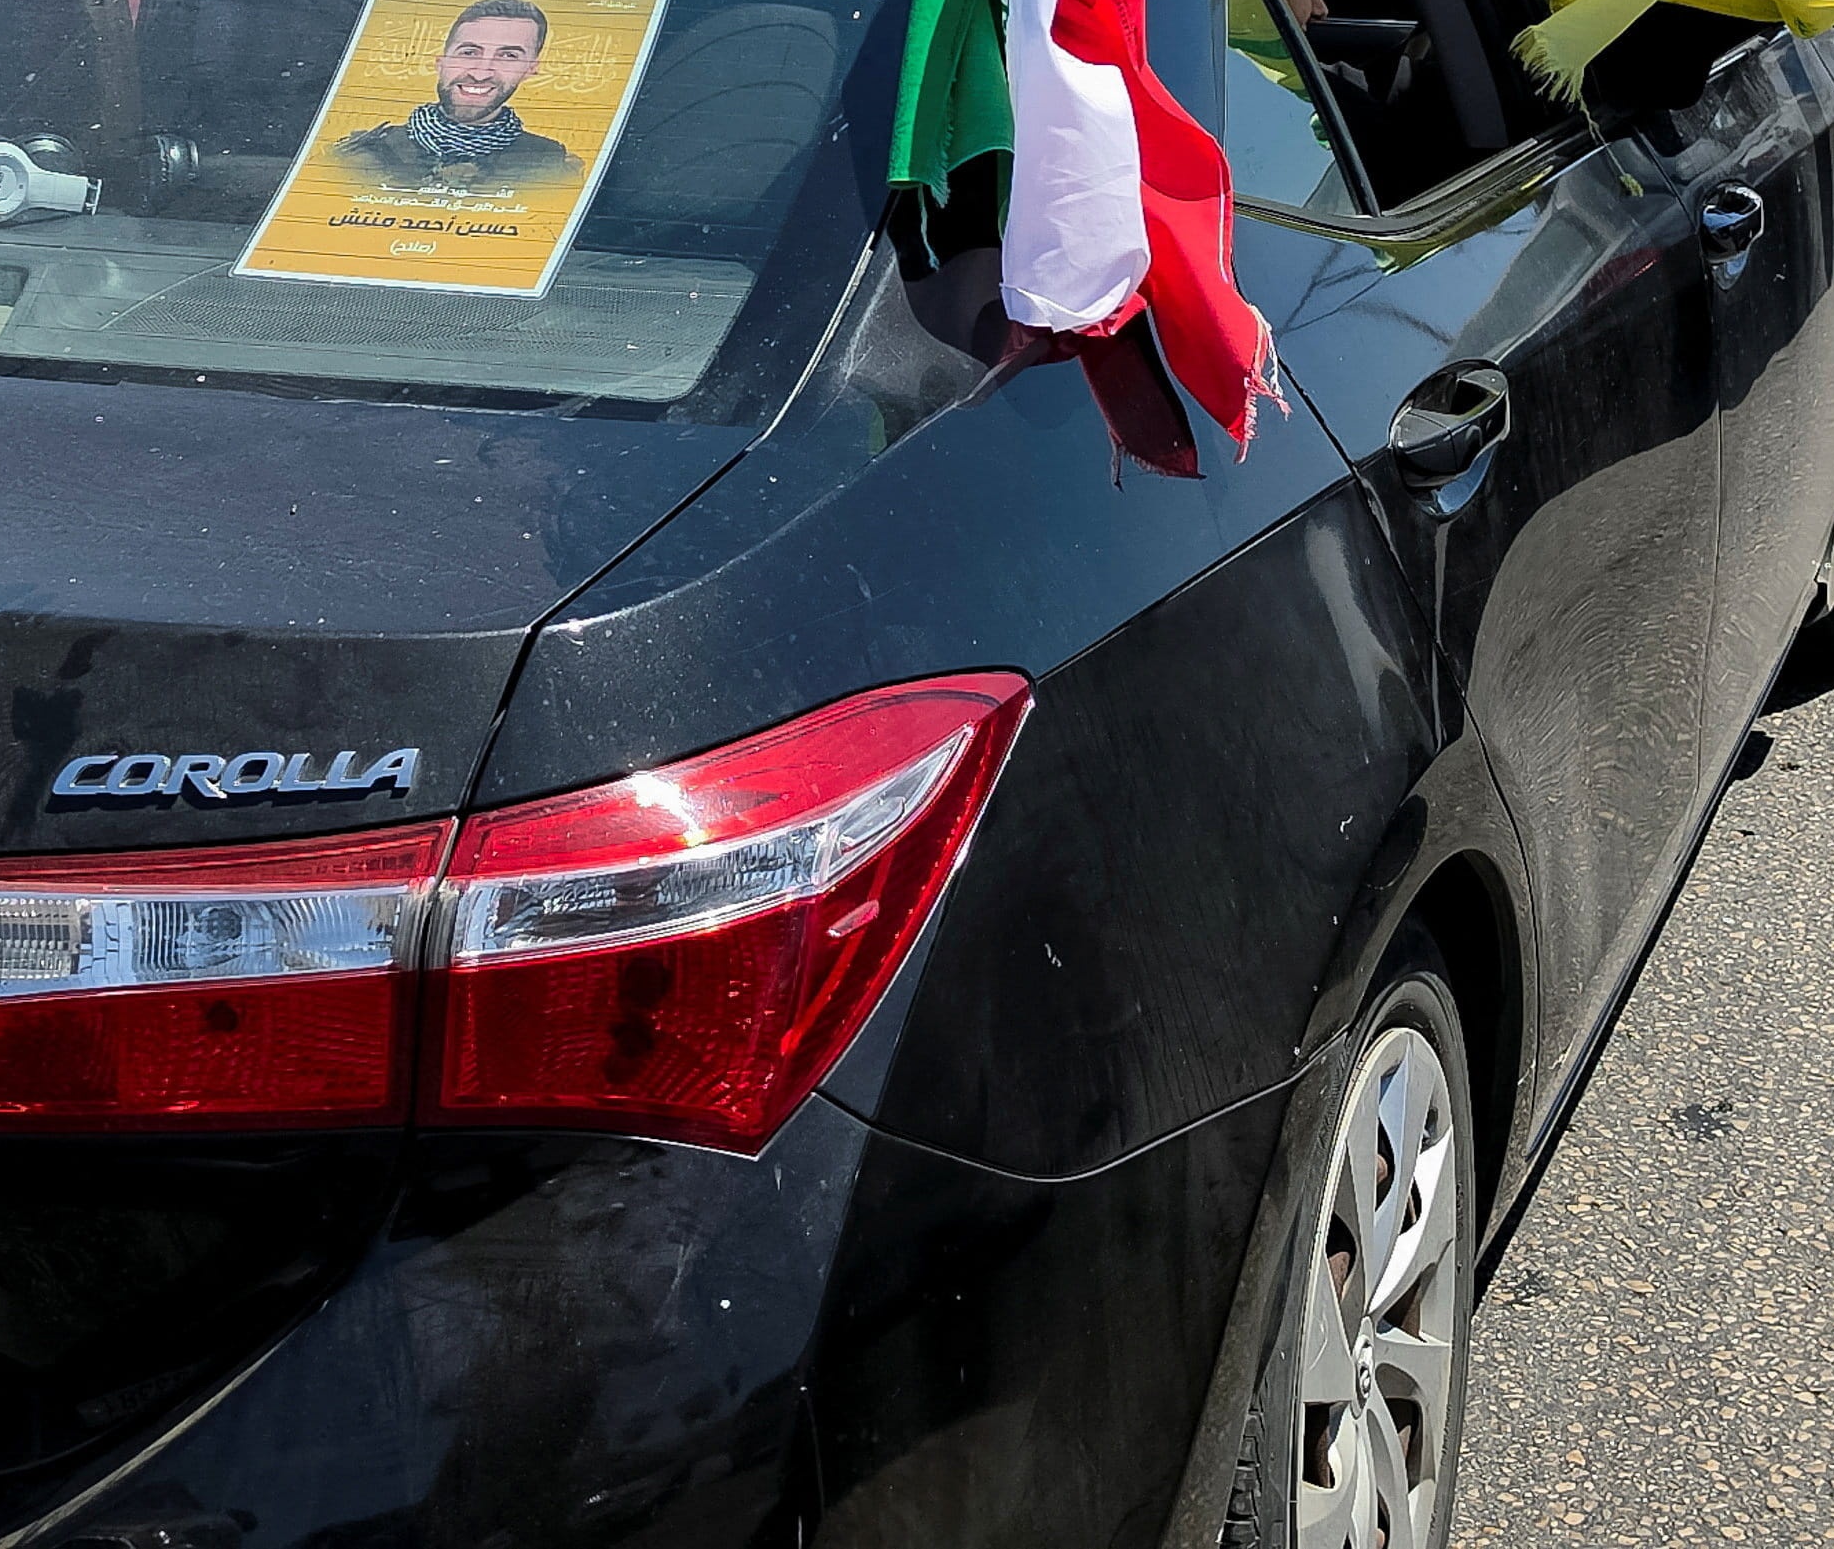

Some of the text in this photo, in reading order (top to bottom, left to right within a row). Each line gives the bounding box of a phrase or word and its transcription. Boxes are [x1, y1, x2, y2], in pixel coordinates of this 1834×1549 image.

[399, 215, 457, 232] أحمد
[456, 221, 518, 237] حسين
[52, 747, 420, 799] COROLLA
